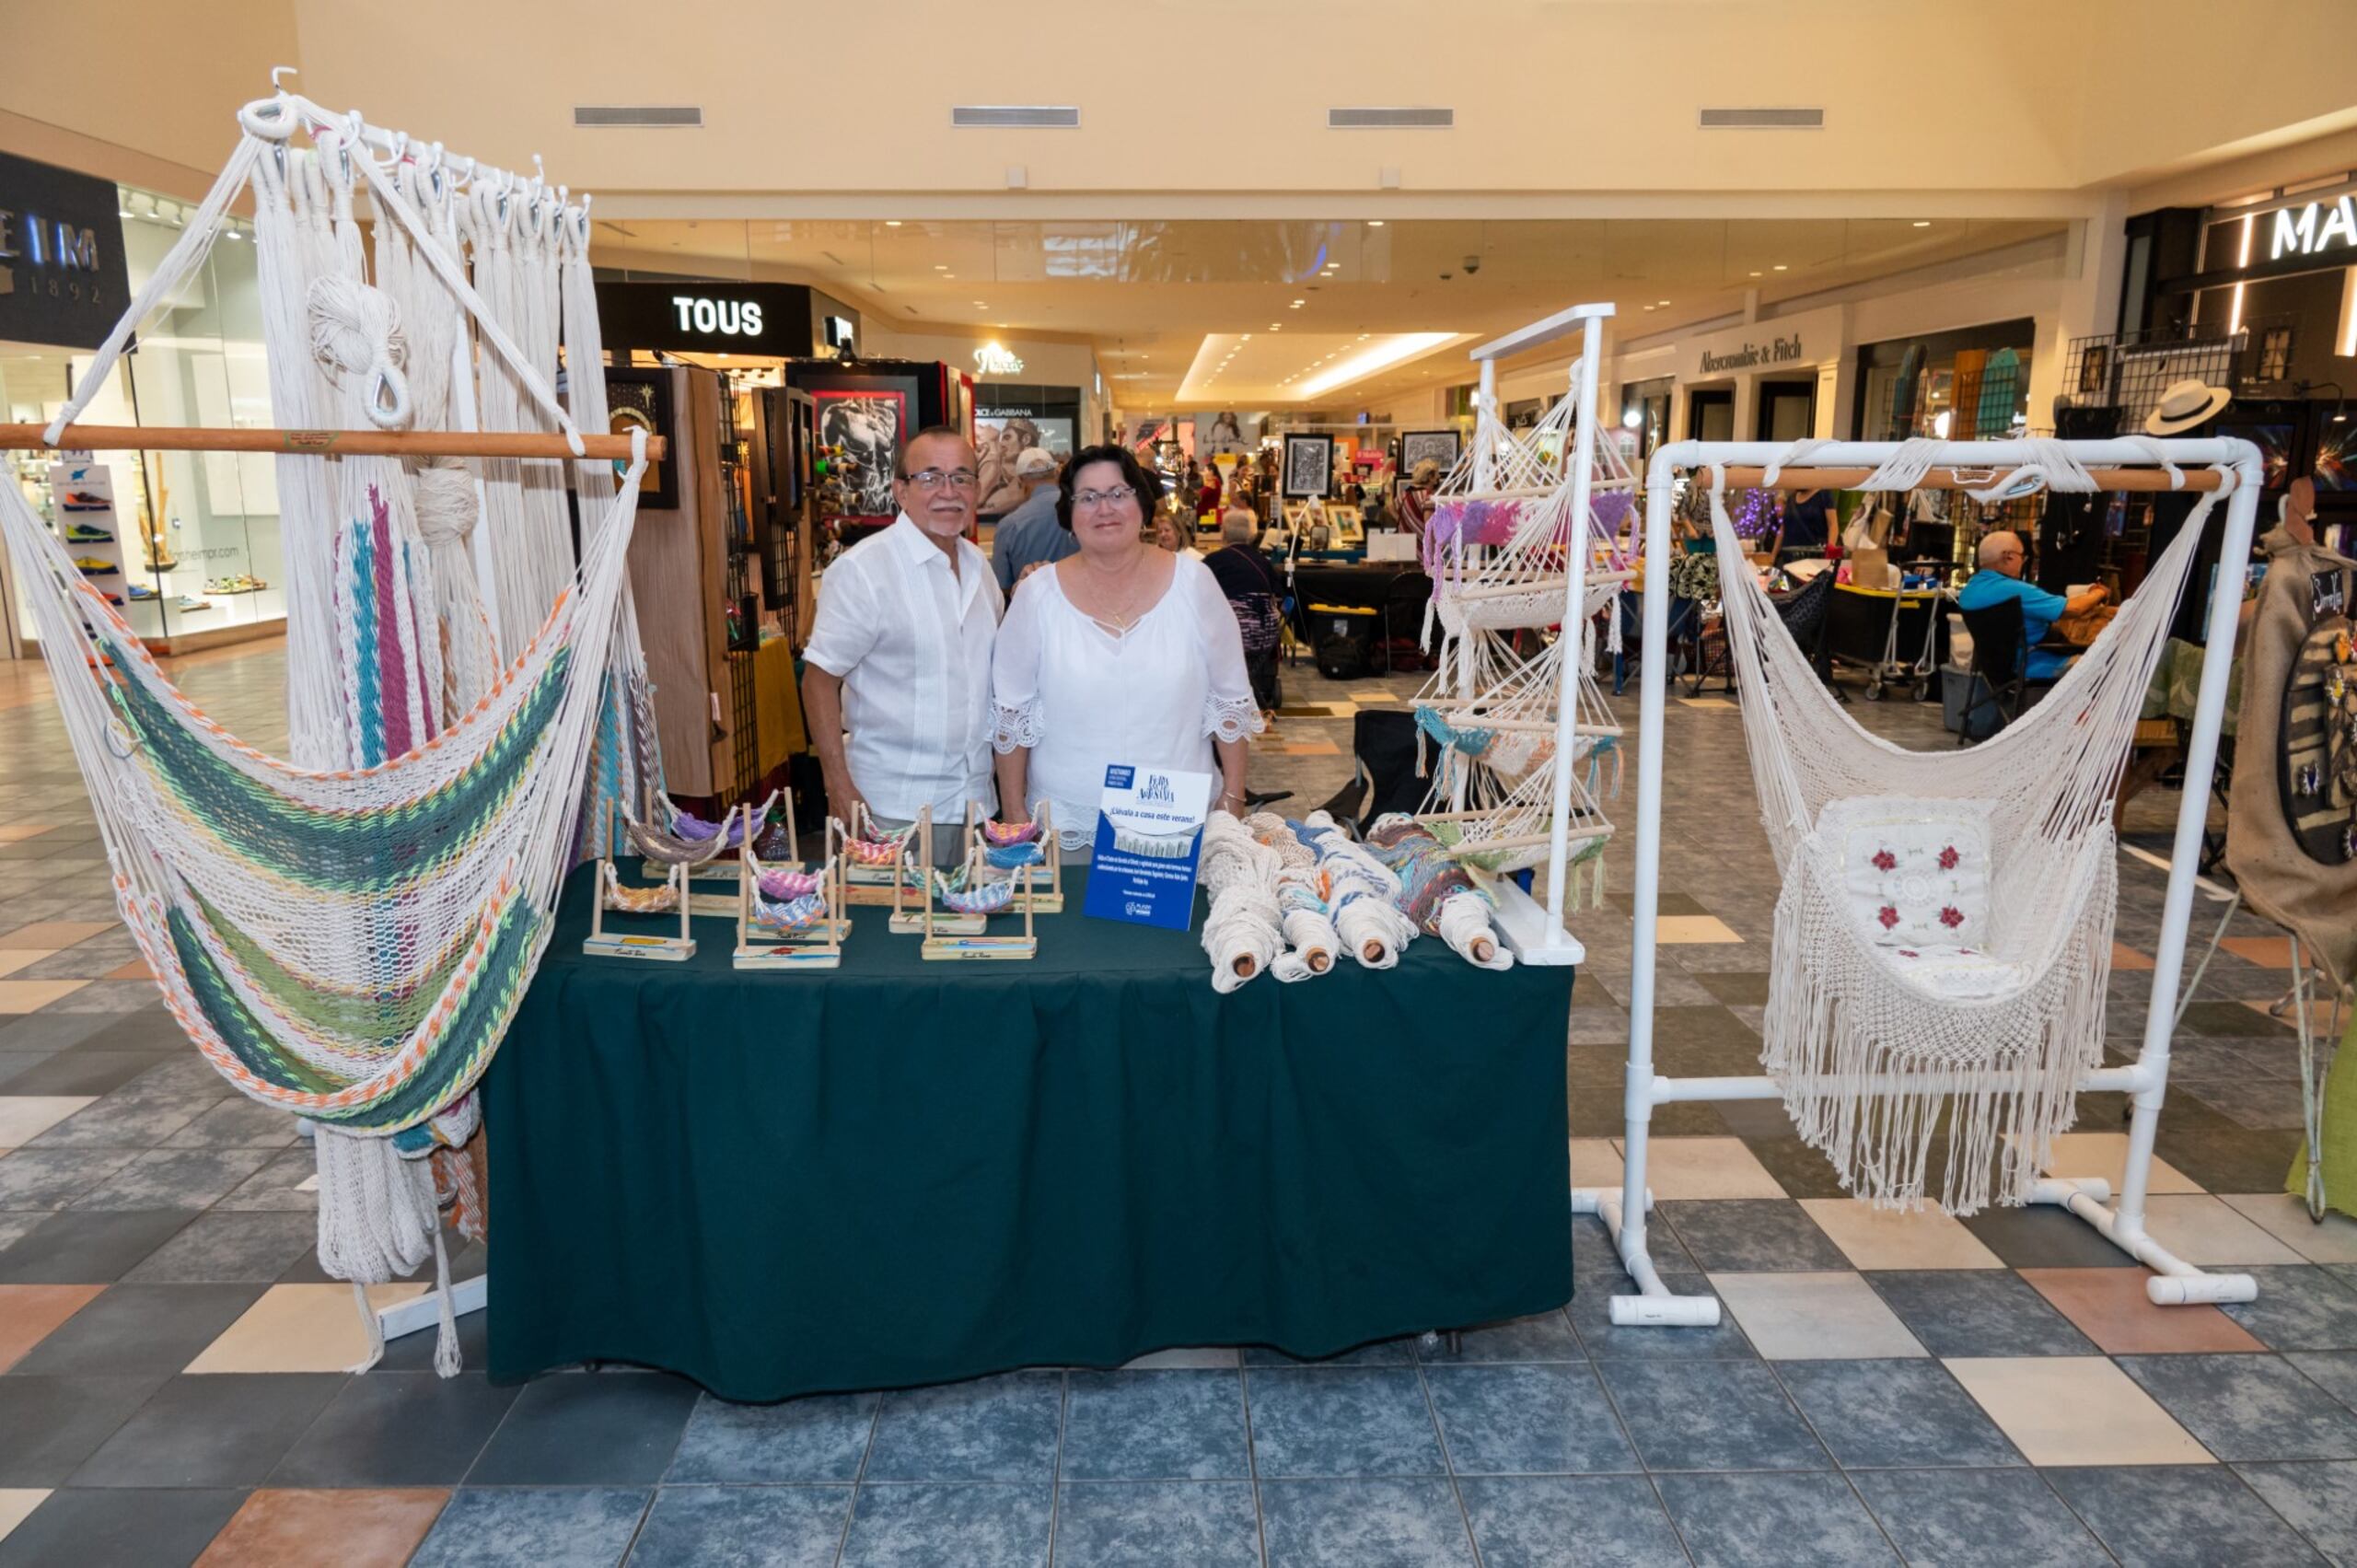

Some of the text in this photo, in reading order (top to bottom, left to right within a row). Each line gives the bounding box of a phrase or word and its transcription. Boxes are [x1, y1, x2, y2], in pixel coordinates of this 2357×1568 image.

[30, 276, 101, 304] 1892
[672, 296, 763, 336] TOUS
[1700, 332, 1802, 374] Abercrombie & Fitch
[994, 408, 1032, 417] GABBANA
[1141, 811, 1155, 819] casa
[1156, 813, 1170, 821] este
[1172, 815, 1195, 823] verano!
